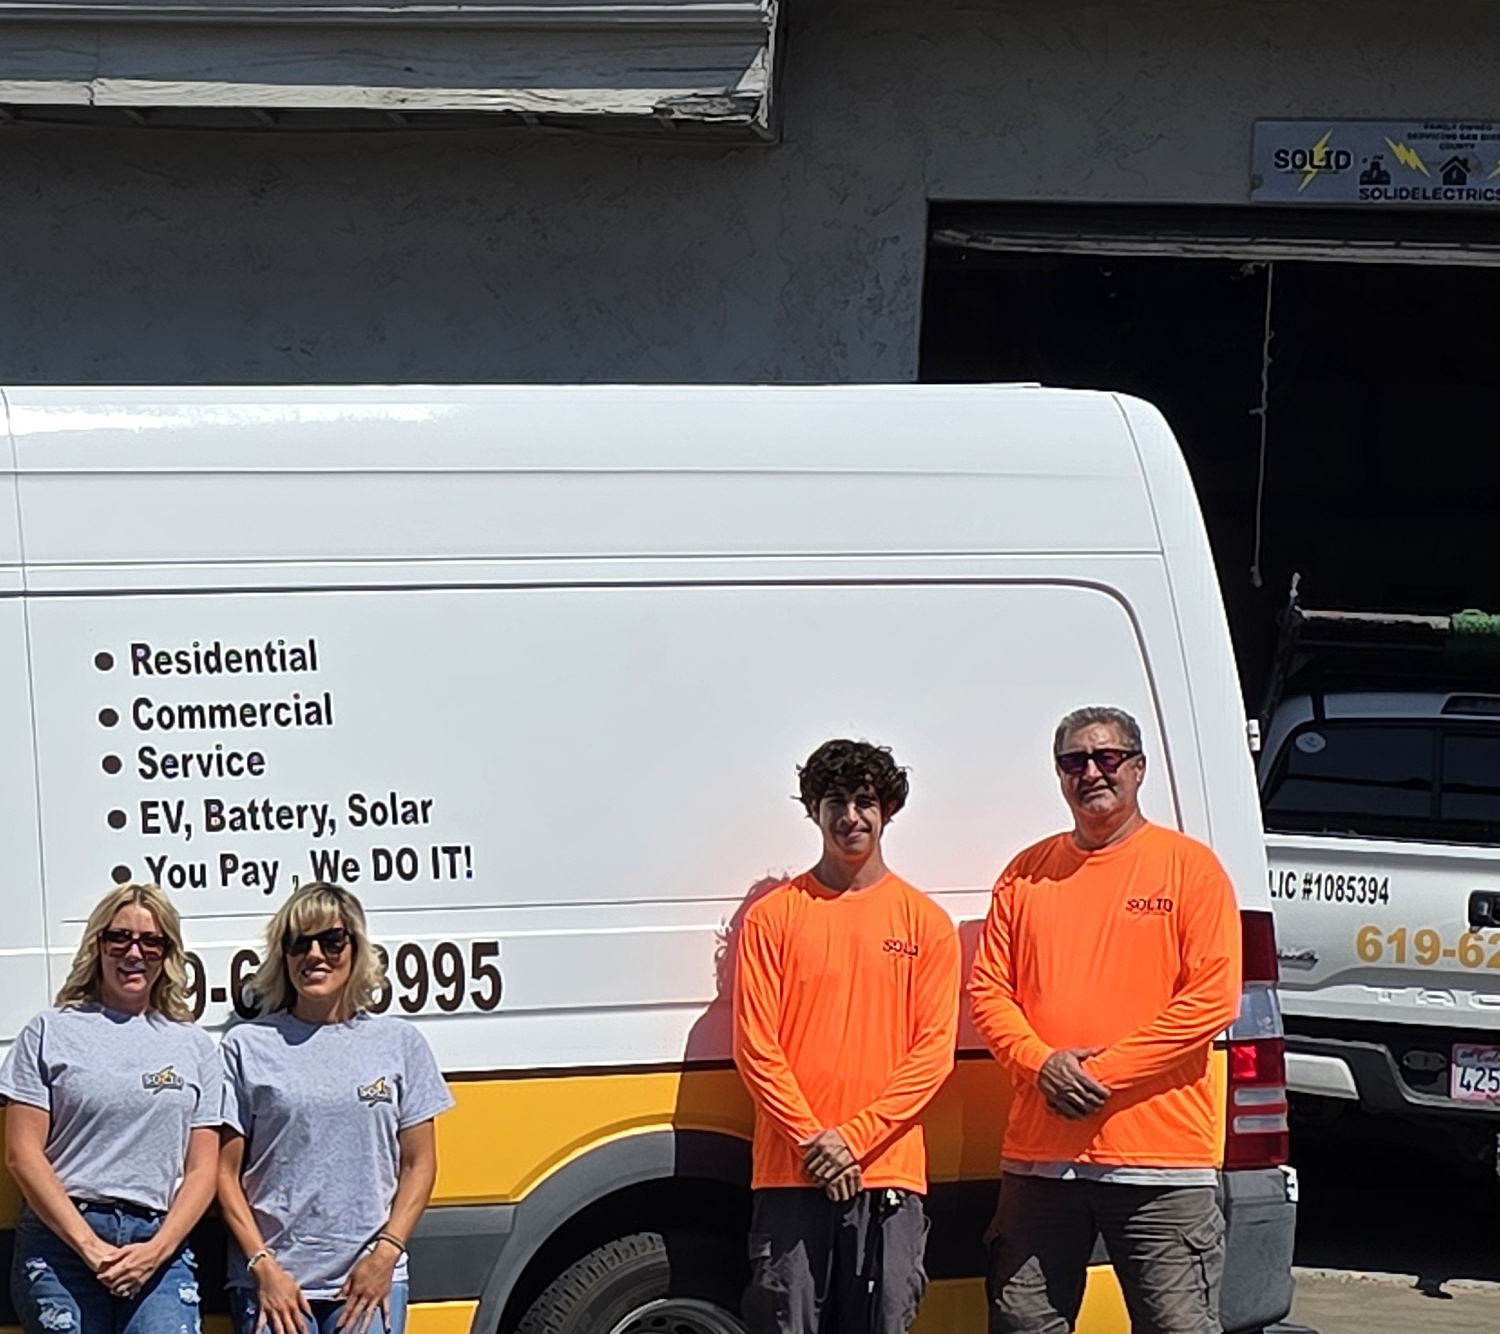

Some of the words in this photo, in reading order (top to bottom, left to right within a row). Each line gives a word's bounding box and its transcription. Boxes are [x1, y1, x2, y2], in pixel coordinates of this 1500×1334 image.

[1274, 148, 1352, 170] SOLID
[130, 638, 318, 677] Residential
[132, 692, 333, 731] Commercial
[137, 743, 266, 780] Service
[139, 799, 193, 841] EV,
[203, 797, 337, 838] Battery,
[347, 791, 434, 828] Solar
[144, 855, 207, 889] You
[219, 853, 279, 895] Pay
[309, 849, 361, 883] We
[372, 847, 418, 882] DO
[431, 845, 474, 880] IT!
[1268, 869, 1298, 900] LIC
[1301, 872, 1390, 905] #1085394
[1459, 1067, 1500, 1092] 425
